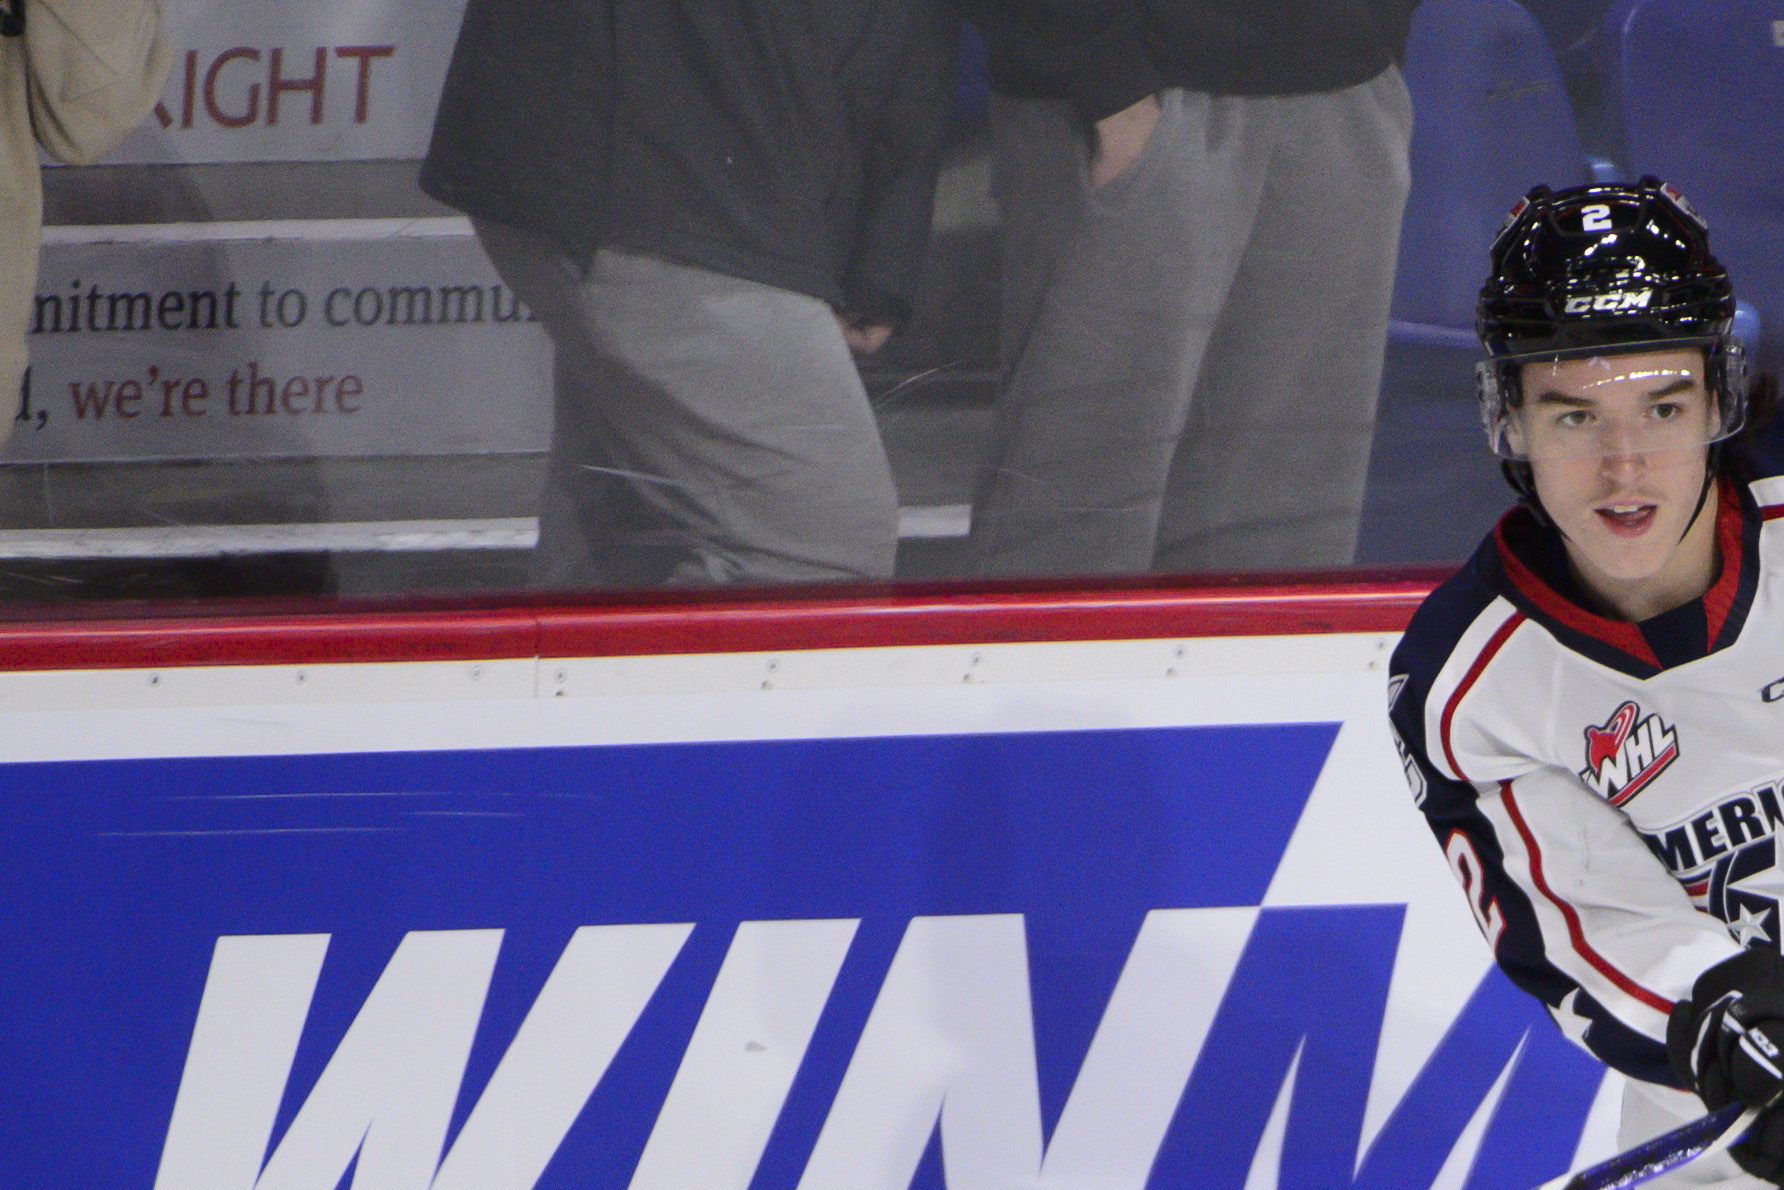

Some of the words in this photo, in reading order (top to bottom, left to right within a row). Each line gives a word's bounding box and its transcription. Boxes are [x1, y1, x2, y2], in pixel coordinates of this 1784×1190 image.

[154, 44, 397, 130] IGHT
[1581, 204, 1613, 232] 2
[259, 280, 307, 328] to
[324, 283, 547, 328] commu
[1564, 288, 1653, 315] CCM
[67, 365, 209, 421] we're
[226, 361, 364, 416] there
[1579, 713, 1675, 799] WHL
